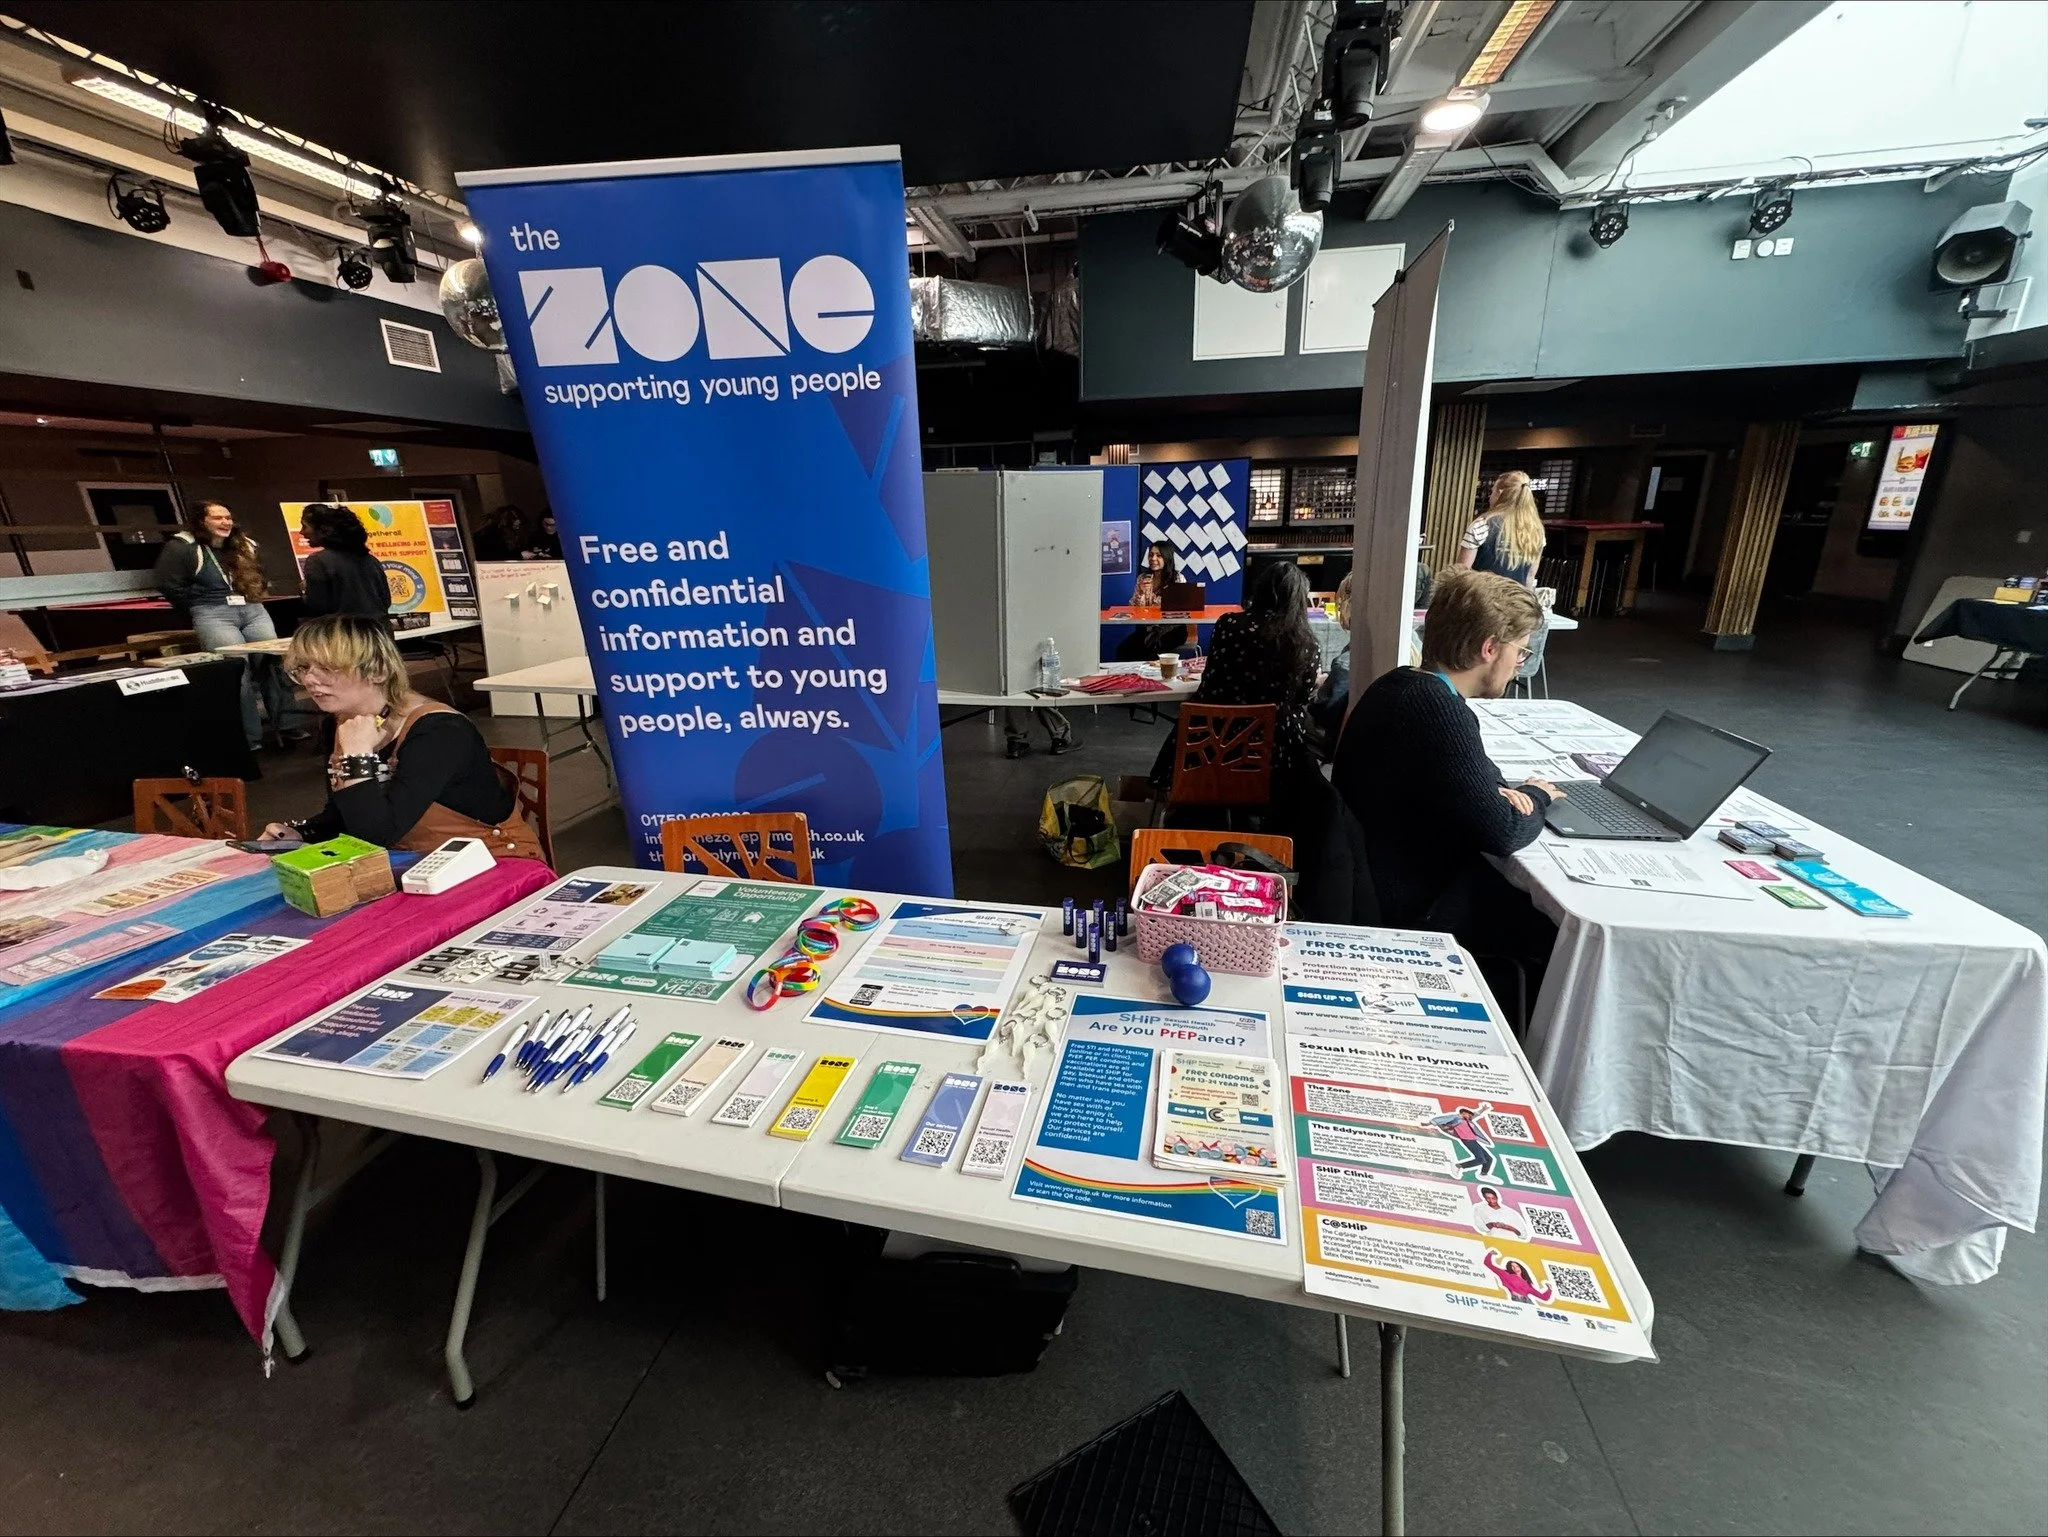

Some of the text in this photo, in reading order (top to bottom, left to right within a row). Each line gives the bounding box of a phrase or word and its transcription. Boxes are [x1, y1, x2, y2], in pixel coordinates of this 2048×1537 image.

[510, 222, 560, 251] the
[544, 363, 881, 408] supporting young people
[579, 531, 729, 564] Free and
[592, 575, 784, 609] confidential
[600, 619, 856, 652] information and
[610, 665, 887, 698] support to young
[619, 704, 849, 738] people, always.
[733, 891, 801, 902] Opportunity
[736, 886, 807, 898] Volunteering
[656, 983, 687, 995] ME
[1089, 1021, 1245, 1046] Are you PrEPared?
[1066, 1060, 1106, 1068] vaccinations
[1299, 1042, 1344, 1052] Sexual
[1348, 1047, 1395, 1058] Health
[1416, 1055, 1489, 1069] Plymouth
[1093, 1124, 1124, 1132] yourself.
[1106, 1118, 1122, 1126] help
[1045, 1131, 1091, 1142] confidential.
[1332, 1126, 1386, 1138] Eddystone
[1389, 1134, 1416, 1142] Trust
[1315, 1165, 1373, 1179] SHiP Clinic
[1045, 1184, 1100, 1196] www.yourship.uk
[1132, 1197, 1171, 1208] information
[1322, 1218, 1368, 1233] C@SHiP
